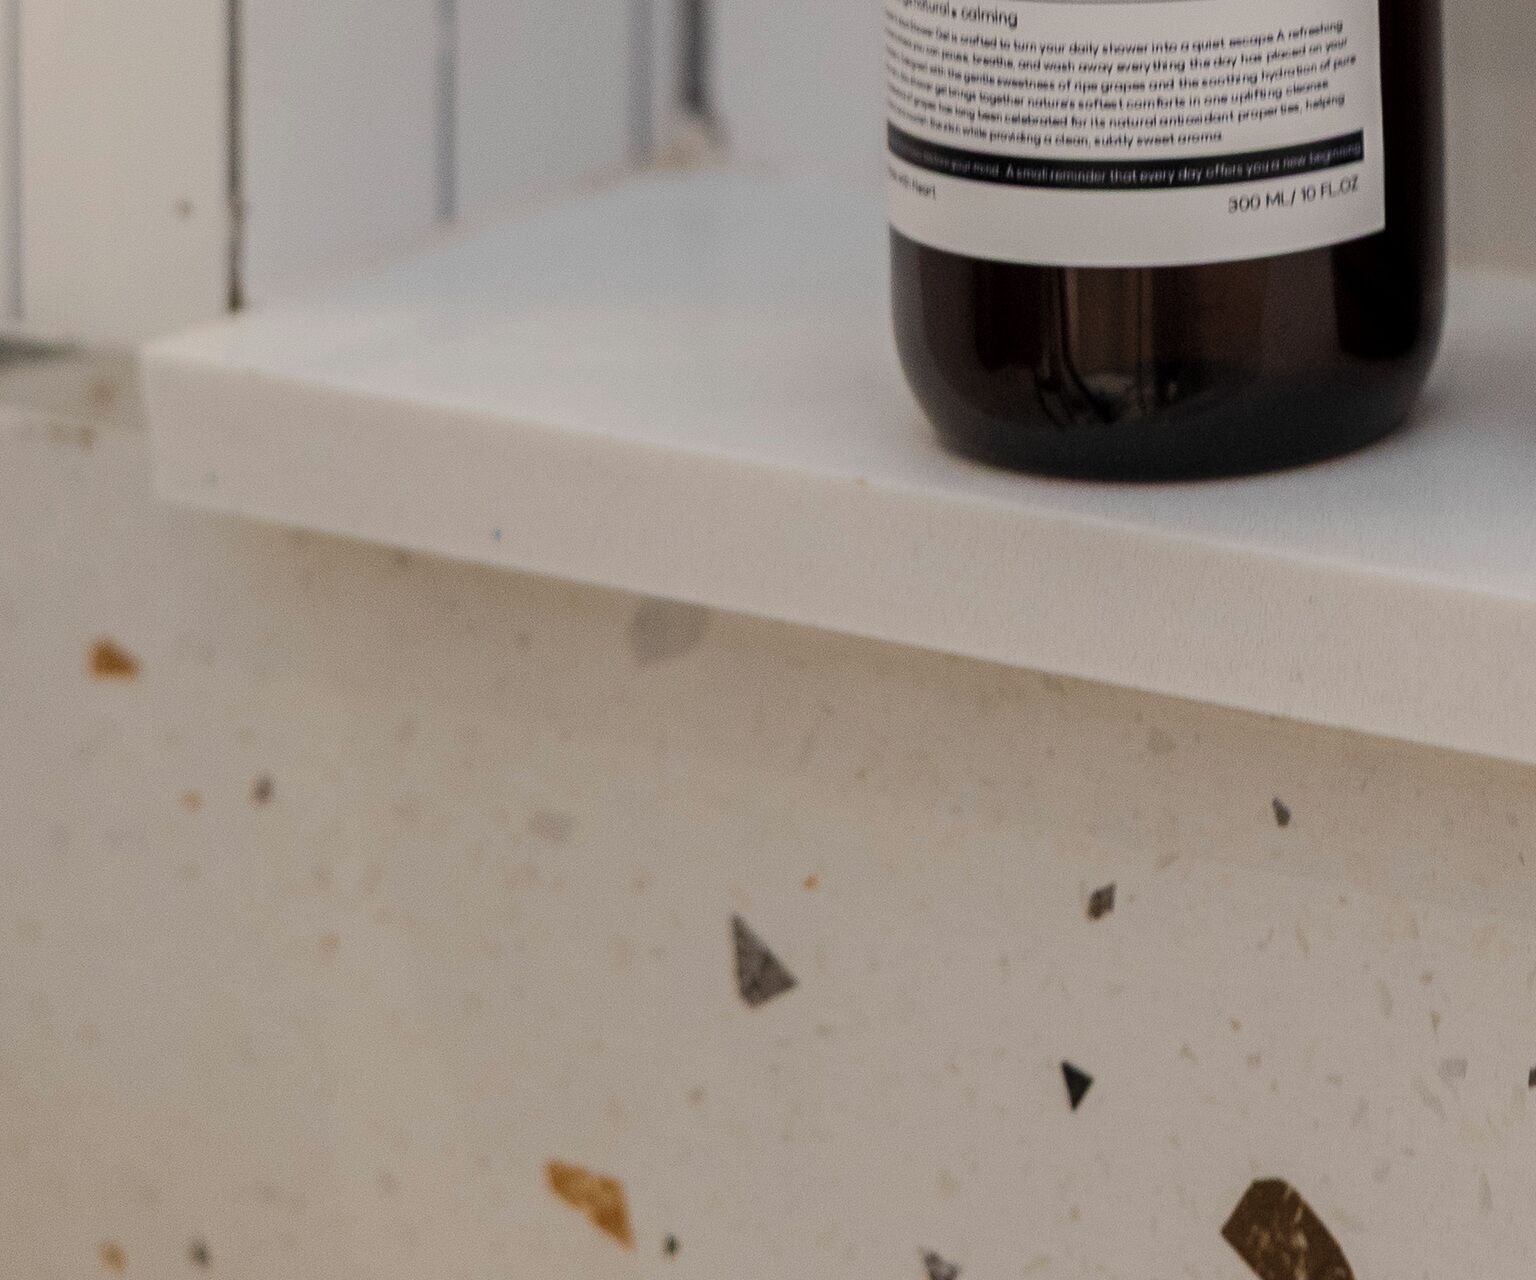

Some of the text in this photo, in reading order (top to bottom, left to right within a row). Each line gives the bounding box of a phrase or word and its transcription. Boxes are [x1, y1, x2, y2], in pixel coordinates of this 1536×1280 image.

[961, 5, 1018, 30] calming
[1151, 41, 1178, 54] into
[1192, 37, 1225, 54] quiet
[1288, 20, 1344, 40] refreshing
[1189, 57, 1211, 70] the
[1213, 55, 1237, 69] day
[1240, 53, 1263, 65] has
[1266, 44, 1307, 65] placed
[1148, 78, 1175, 91] and
[1178, 76, 1199, 89] the
[1201, 73, 1258, 88] soothing
[1261, 63, 1318, 84] hydration
[1159, 110, 1234, 127] antioxidant
[1305, 93, 1346, 110] helping
[1203, 94, 1228, 106] one
[1231, 88, 1283, 105] uplifting
[1178, 167, 1202, 183] day
[1205, 163, 1243, 178] offers
[1246, 160, 1270, 178] you
[1228, 195, 1261, 213] 300
[1301, 186, 1317, 202] 10
